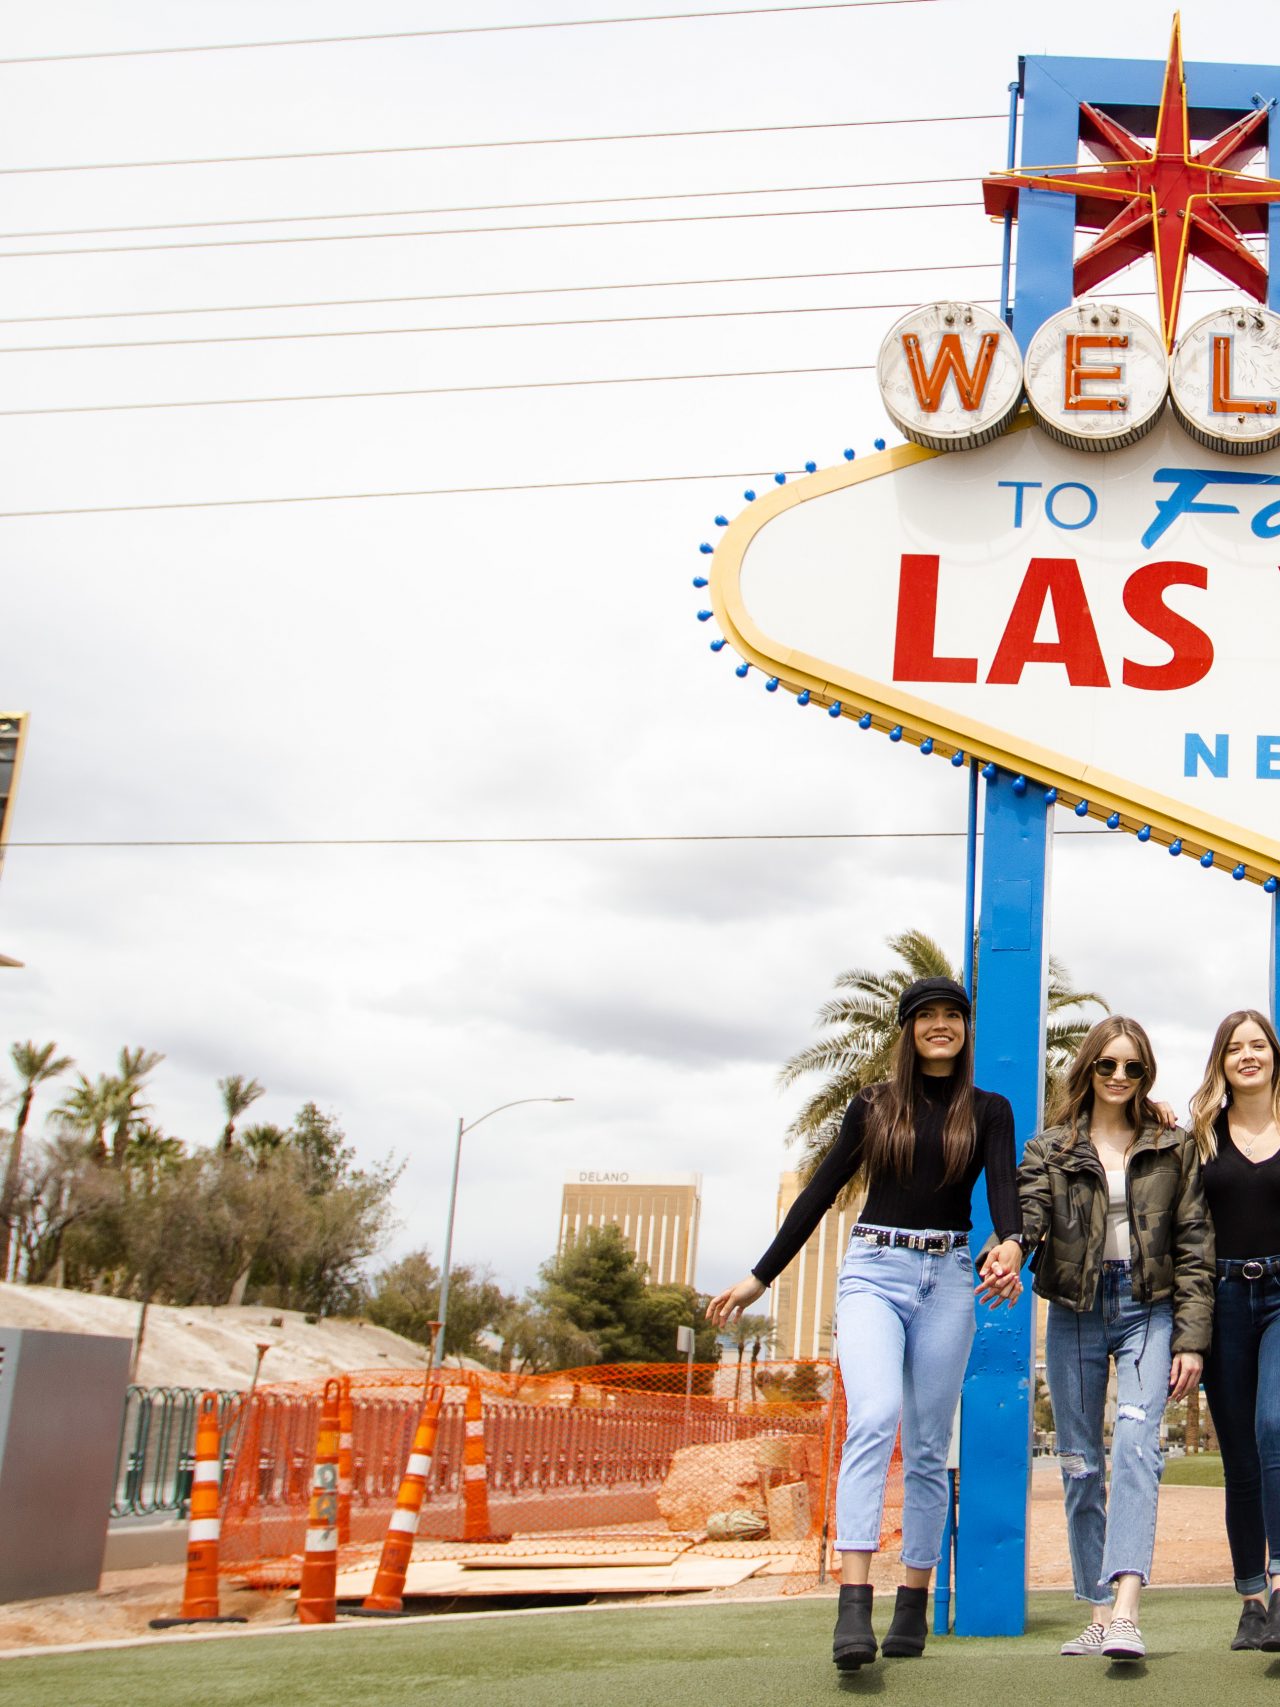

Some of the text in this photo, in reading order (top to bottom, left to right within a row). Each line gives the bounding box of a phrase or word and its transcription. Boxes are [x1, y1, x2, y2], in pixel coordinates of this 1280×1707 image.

[998, 481, 1098, 529] TO
[893, 554, 1214, 690] LAS
[579, 1172, 630, 1183] DELANO
